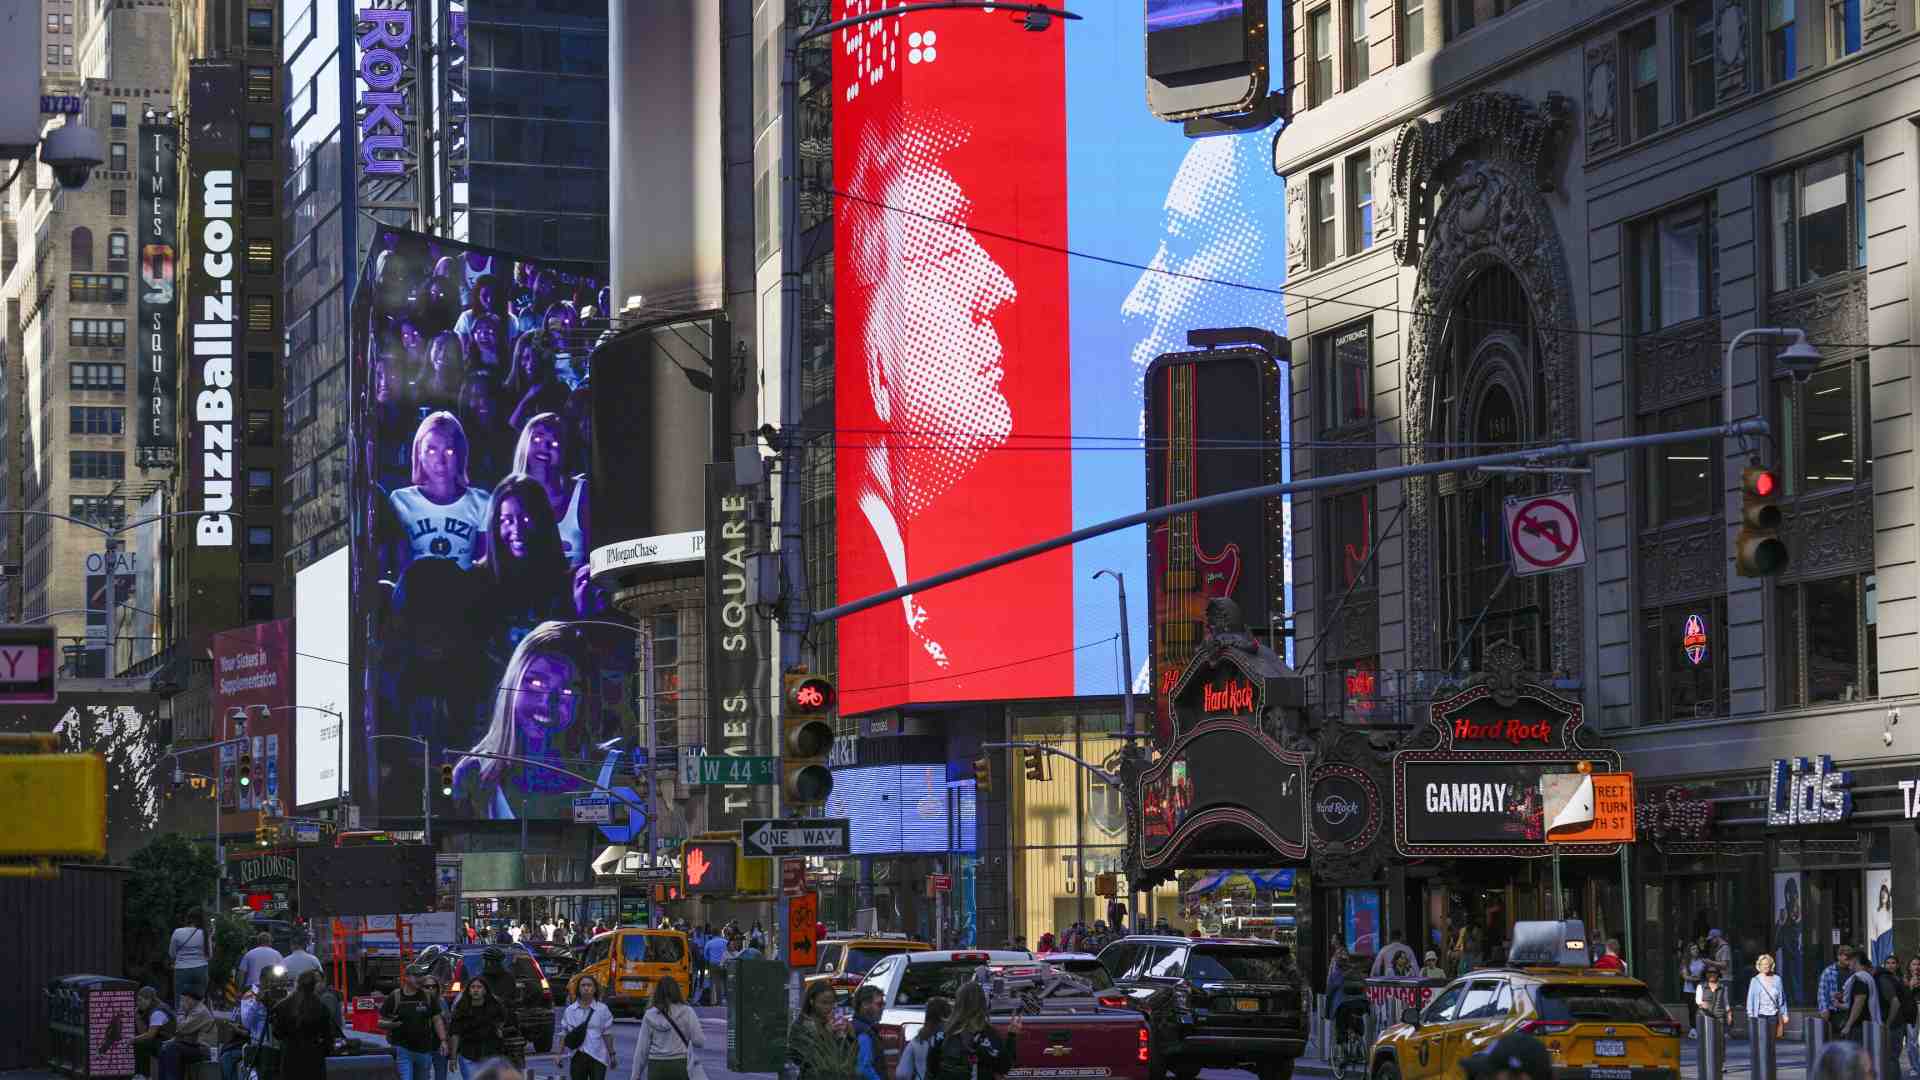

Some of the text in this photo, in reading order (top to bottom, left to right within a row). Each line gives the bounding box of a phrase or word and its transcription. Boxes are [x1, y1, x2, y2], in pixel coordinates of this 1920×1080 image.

[152, 134, 163, 436] TIMES SQUARE
[194, 170, 233, 546] BuzzBallz.com
[445, 517, 472, 540] UZI
[722, 496, 747, 651] SQUARE
[1205, 682, 1228, 712] Hard
[1230, 679, 1253, 715] Rock
[1456, 719, 1552, 744] Hard Rock
[704, 760, 720, 780] W
[729, 760, 752, 780] 44
[1594, 785, 1624, 799] REET
[1768, 755, 1844, 826] Lids
[1600, 801, 1628, 813] TURN
[1612, 818, 1625, 829] ST
[760, 830, 835, 846] ONE WAY
[240, 861, 261, 883] RED
